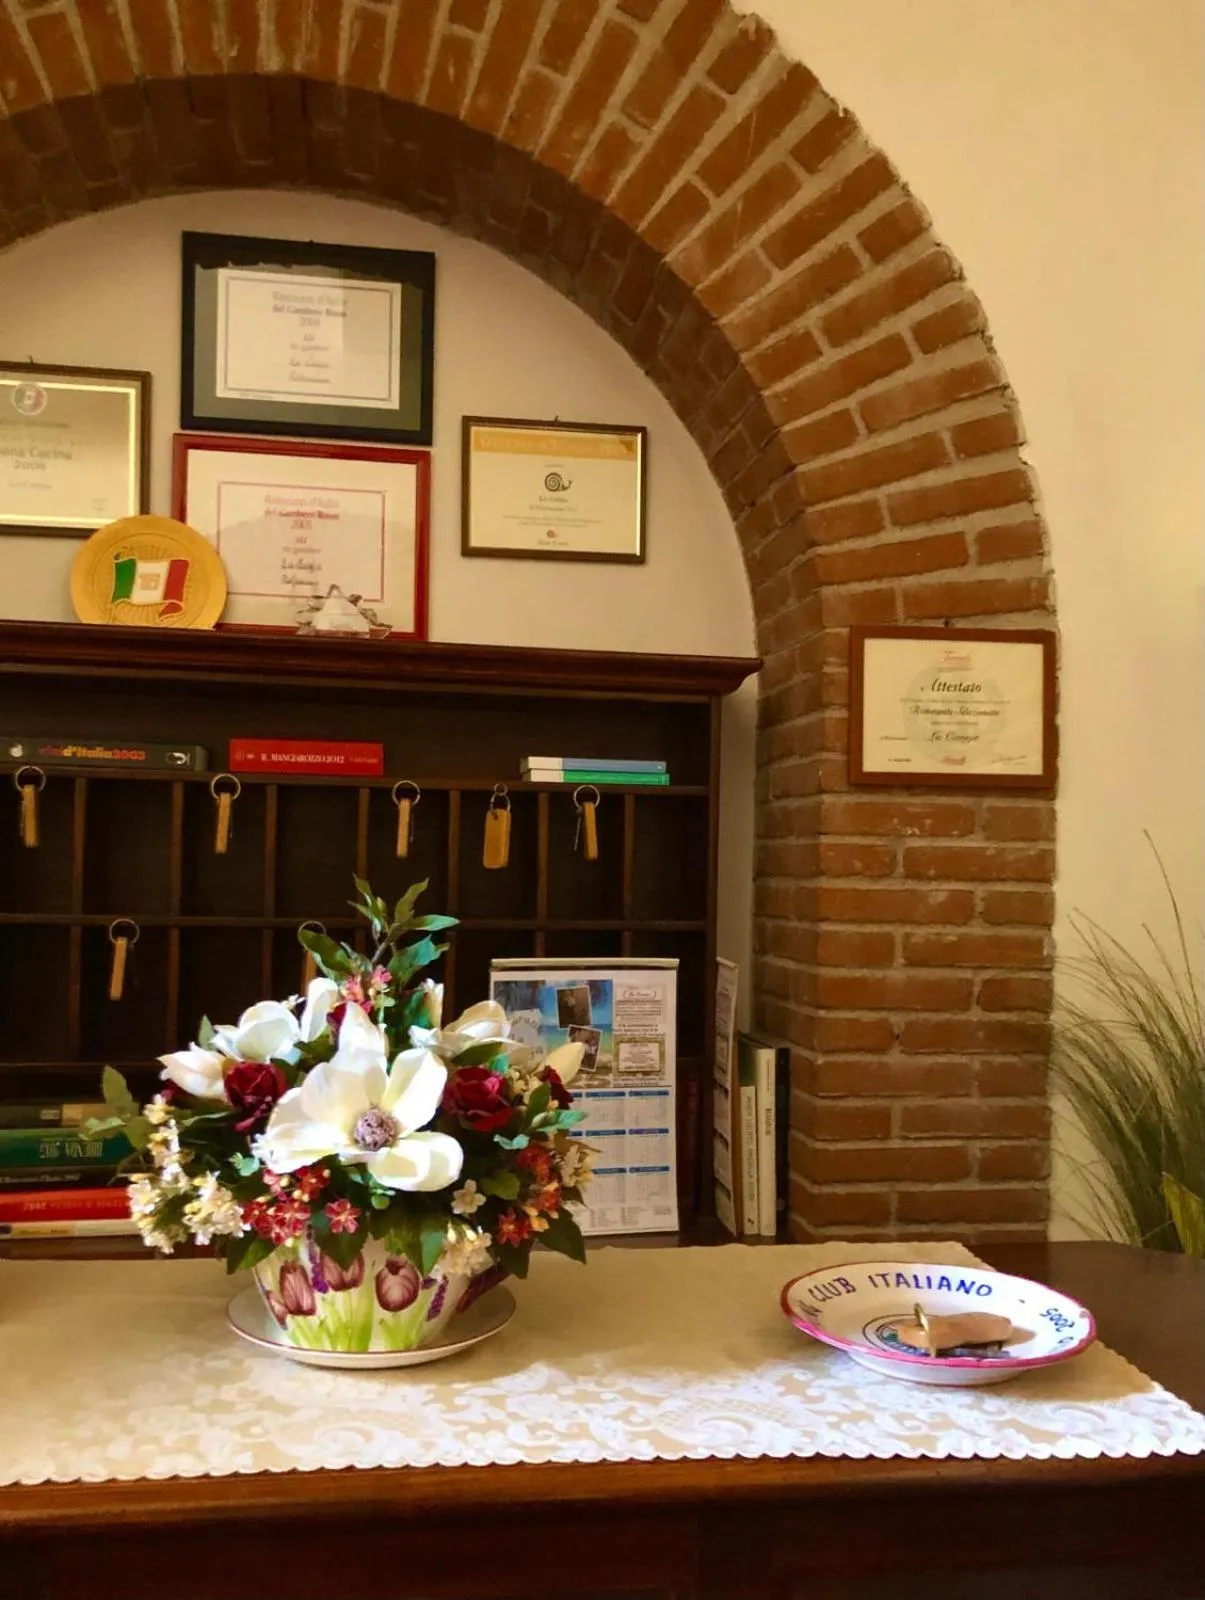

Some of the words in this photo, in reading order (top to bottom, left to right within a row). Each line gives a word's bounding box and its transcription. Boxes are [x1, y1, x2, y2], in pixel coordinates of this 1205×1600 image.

[920, 678, 982, 693] Attestato
[808, 1277, 856, 1302] CLUB
[868, 1272, 992, 1298] ITALIANO
[1039, 1308, 1075, 1332] 2005
